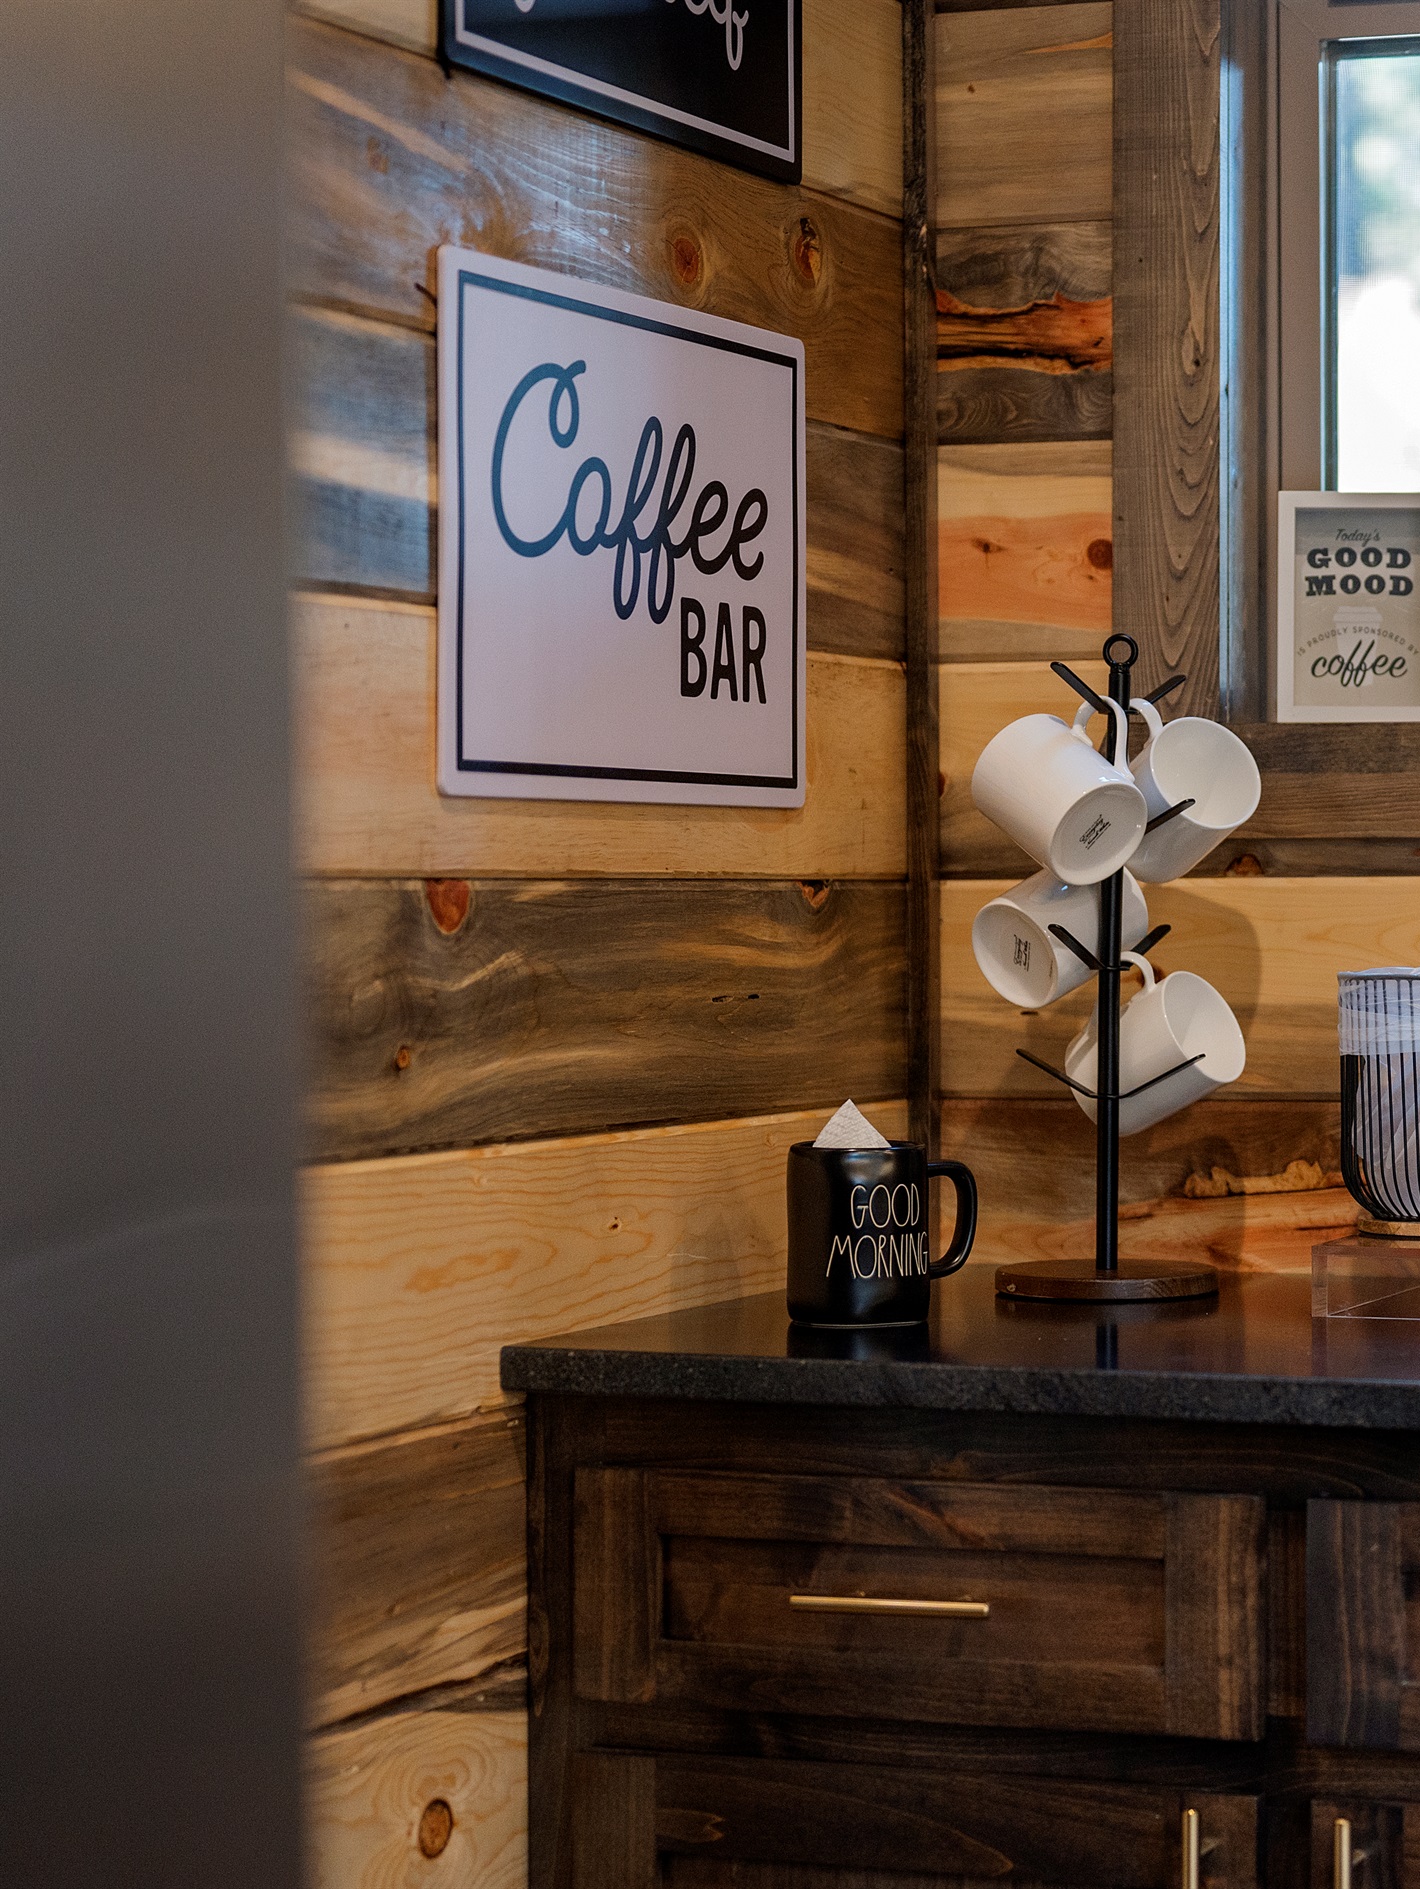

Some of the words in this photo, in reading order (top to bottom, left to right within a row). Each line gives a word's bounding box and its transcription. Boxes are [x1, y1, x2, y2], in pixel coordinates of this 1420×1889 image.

[491, 360, 768, 624] Coffee
[1307, 547, 1411, 569] GOOD
[1335, 529, 1381, 547] Today's
[1305, 574, 1414, 597] MOOD
[680, 597, 767, 704] BAR
[1297, 646, 1306, 657] IS
[1307, 626, 1348, 648] PROUDLY
[1353, 626, 1406, 645] SPONSORED
[1407, 643, 1419, 656] BY
[1311, 639, 1408, 687] coffee
[850, 1183, 920, 1229] GOOD
[826, 1231, 928, 1279] MORNING
